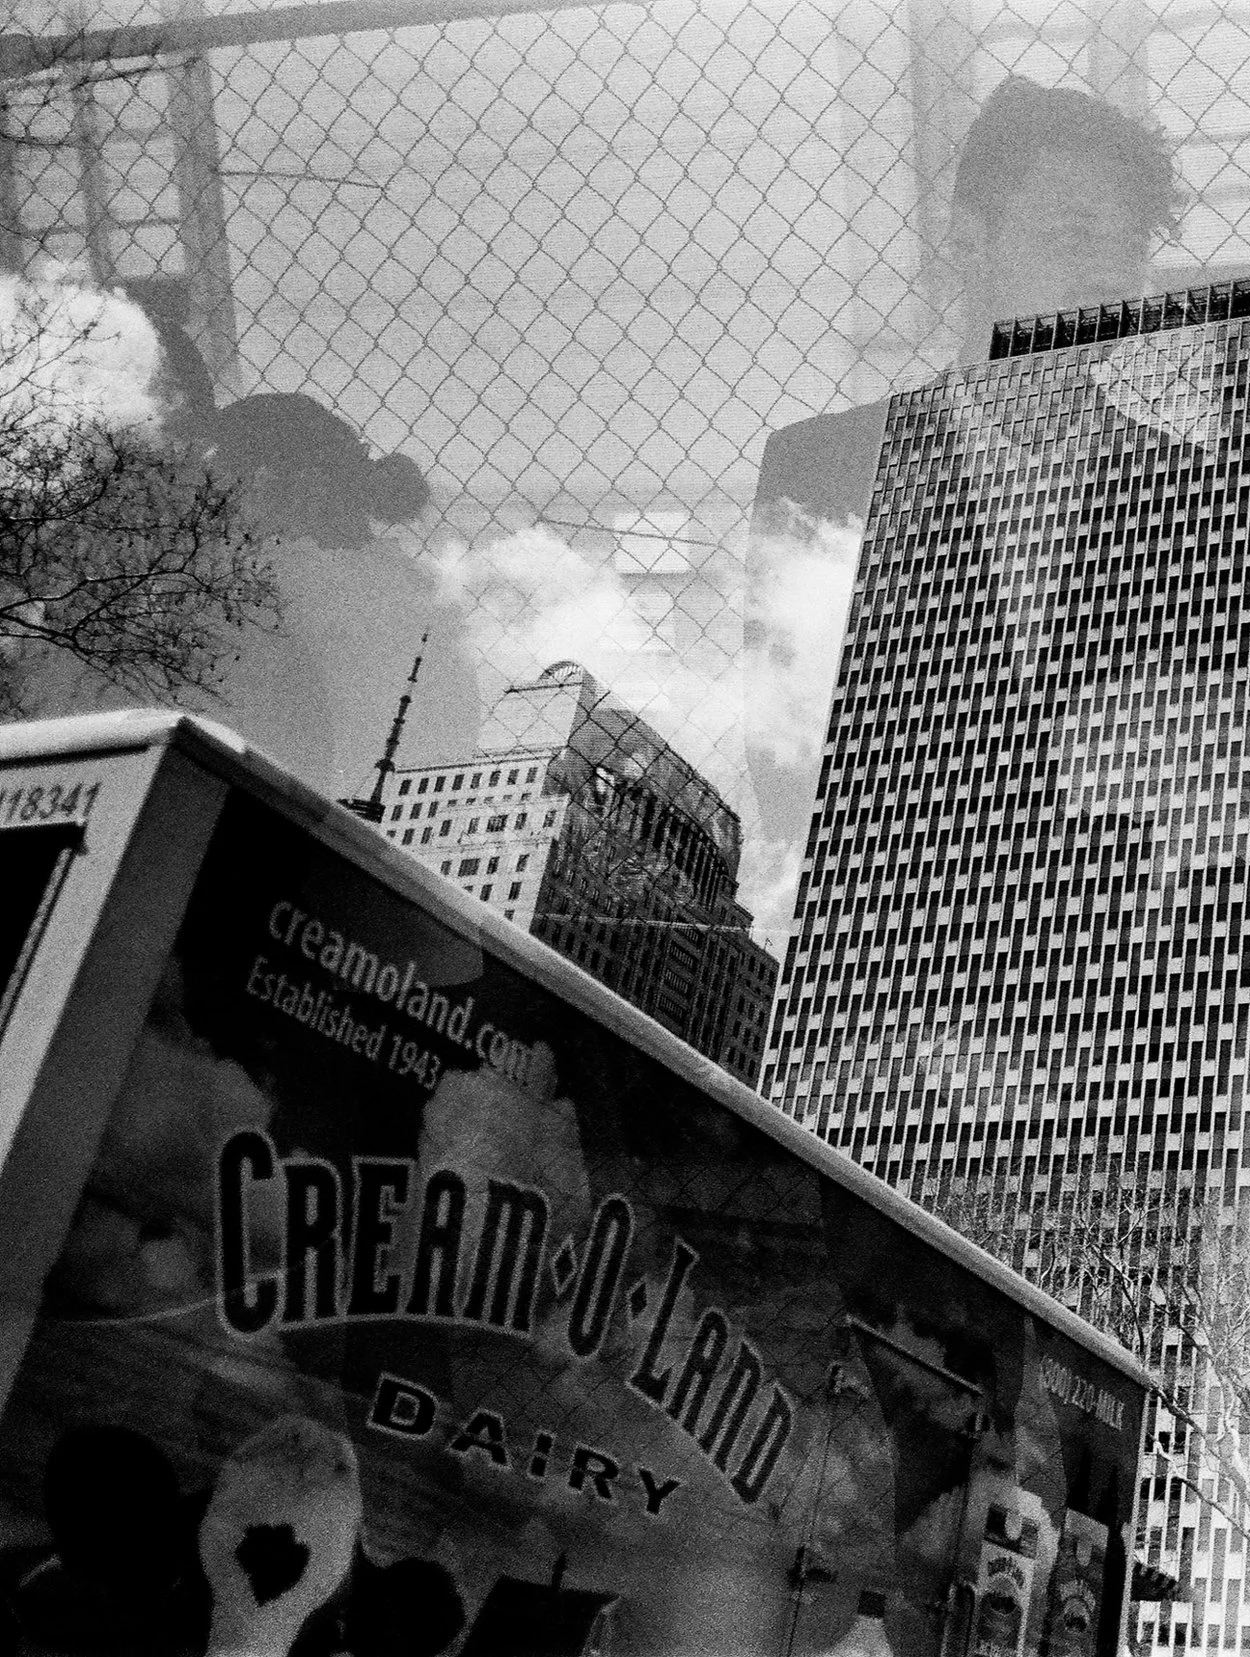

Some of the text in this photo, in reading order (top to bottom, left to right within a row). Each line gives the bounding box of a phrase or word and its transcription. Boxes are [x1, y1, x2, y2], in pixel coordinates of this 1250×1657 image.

[0, 782, 101, 822] 18341
[246, 955, 442, 1090] Established 1943
[268, 900, 534, 1085] creamoland.com
[366, 1370, 685, 1516] DAIRY
